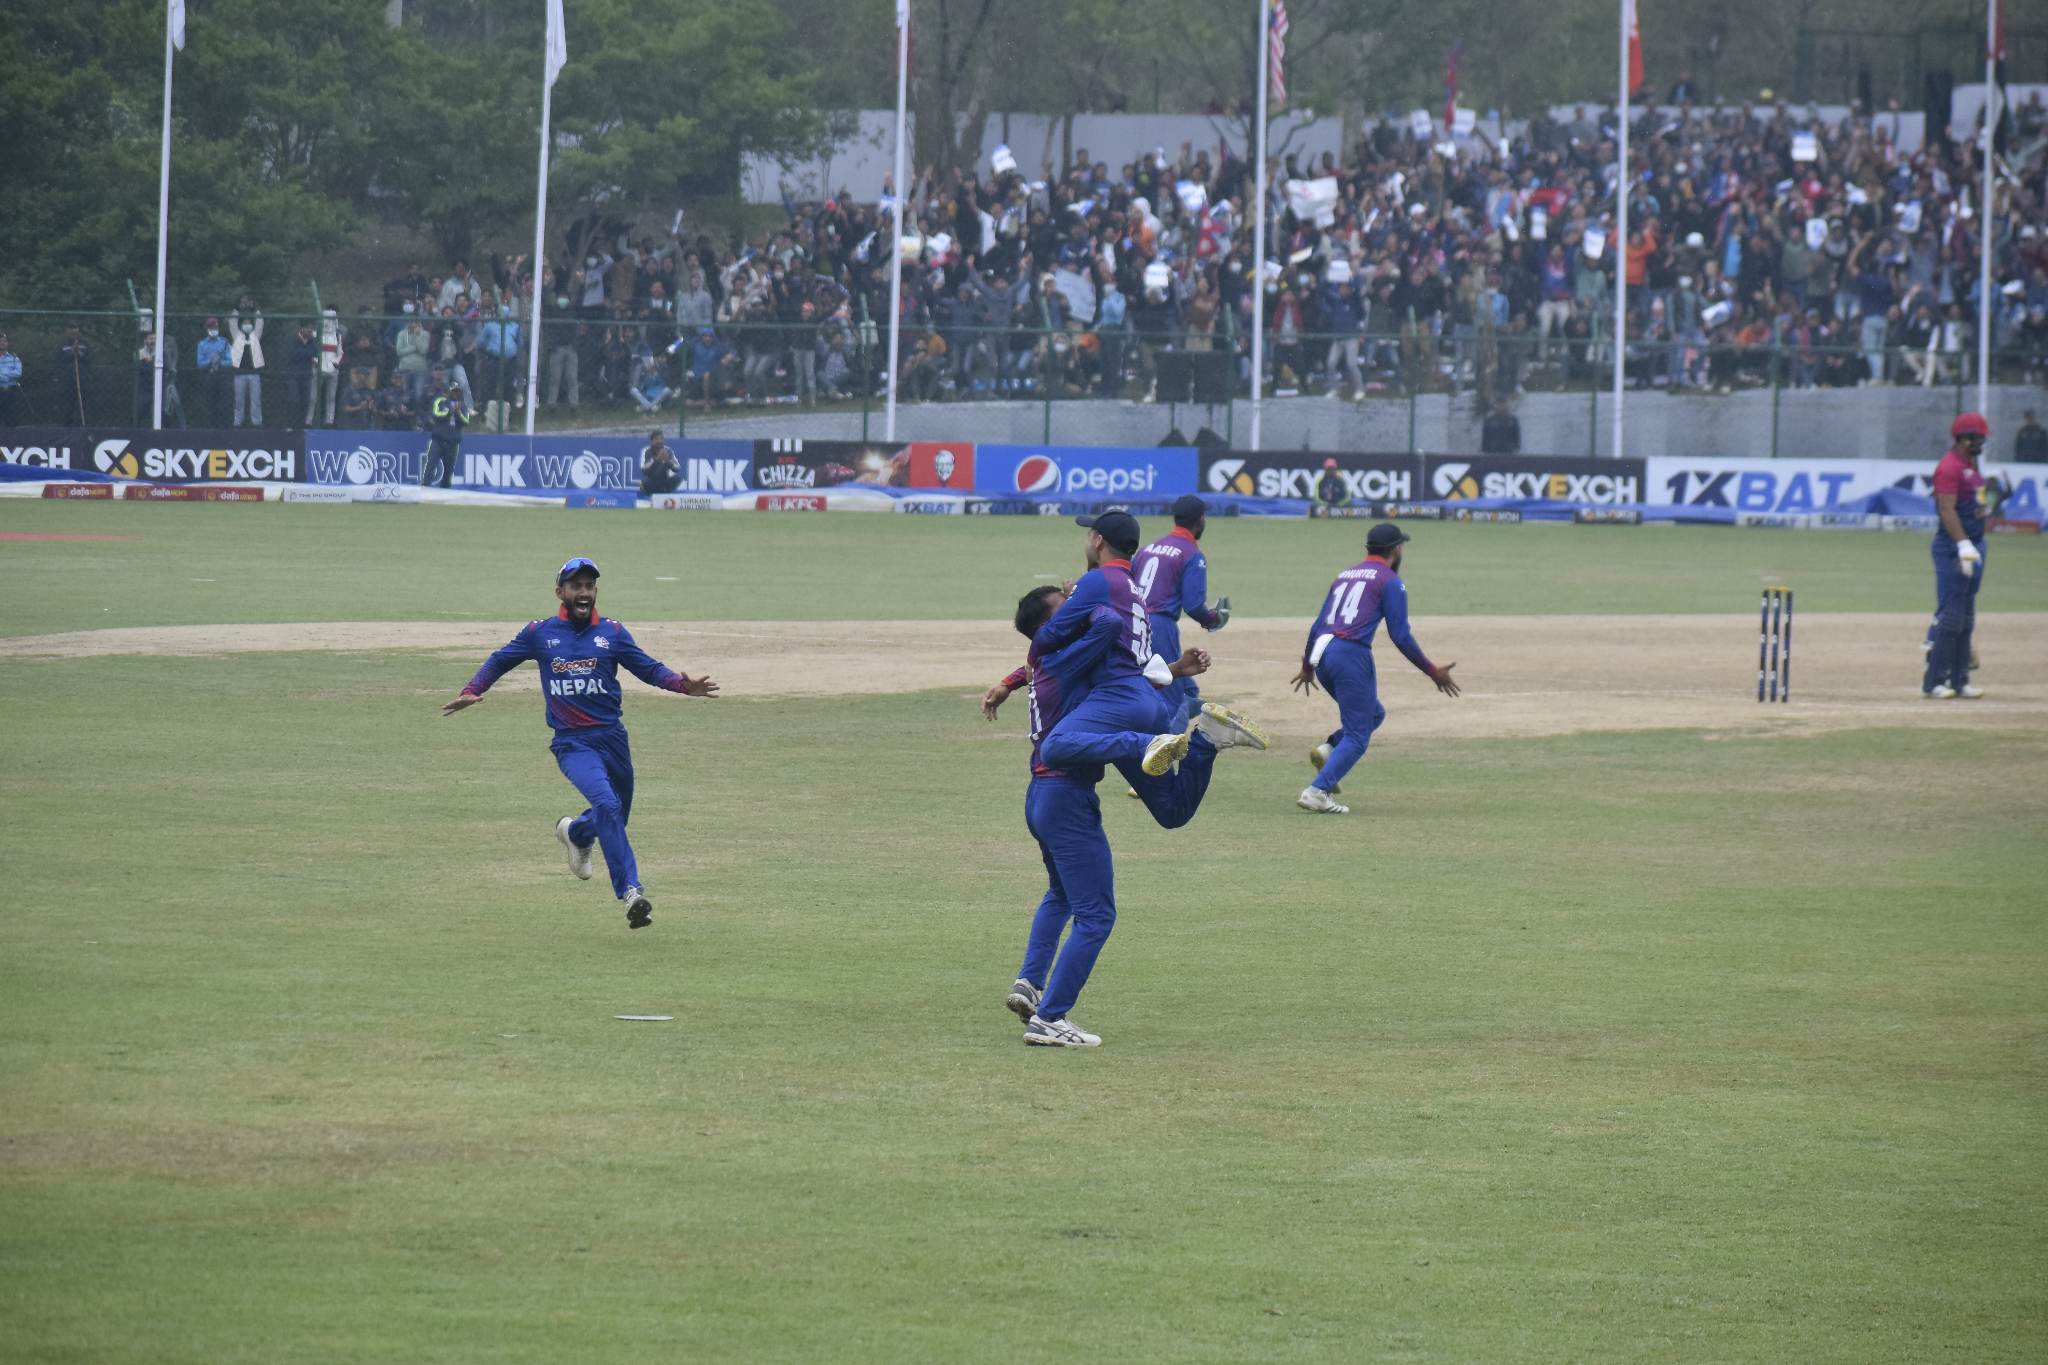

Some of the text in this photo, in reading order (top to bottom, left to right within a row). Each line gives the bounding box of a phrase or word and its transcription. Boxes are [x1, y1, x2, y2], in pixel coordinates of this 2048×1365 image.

[144, 448, 295, 479] SKYEXCH
[676, 458, 749, 491] INK
[759, 464, 816, 489] CHIZZA
[1067, 463, 1154, 495] pepsi
[1258, 467, 1411, 500] SKYXCH
[1483, 471, 1638, 504] SKYEXCH
[1666, 470, 1855, 513] 1XBAT
[784, 498, 819, 511] KFC
[1144, 544, 1183, 557] AASIF
[1139, 556, 1160, 601] 9
[1327, 581, 1367, 625] 14
[550, 678, 608, 695] NEPAL
